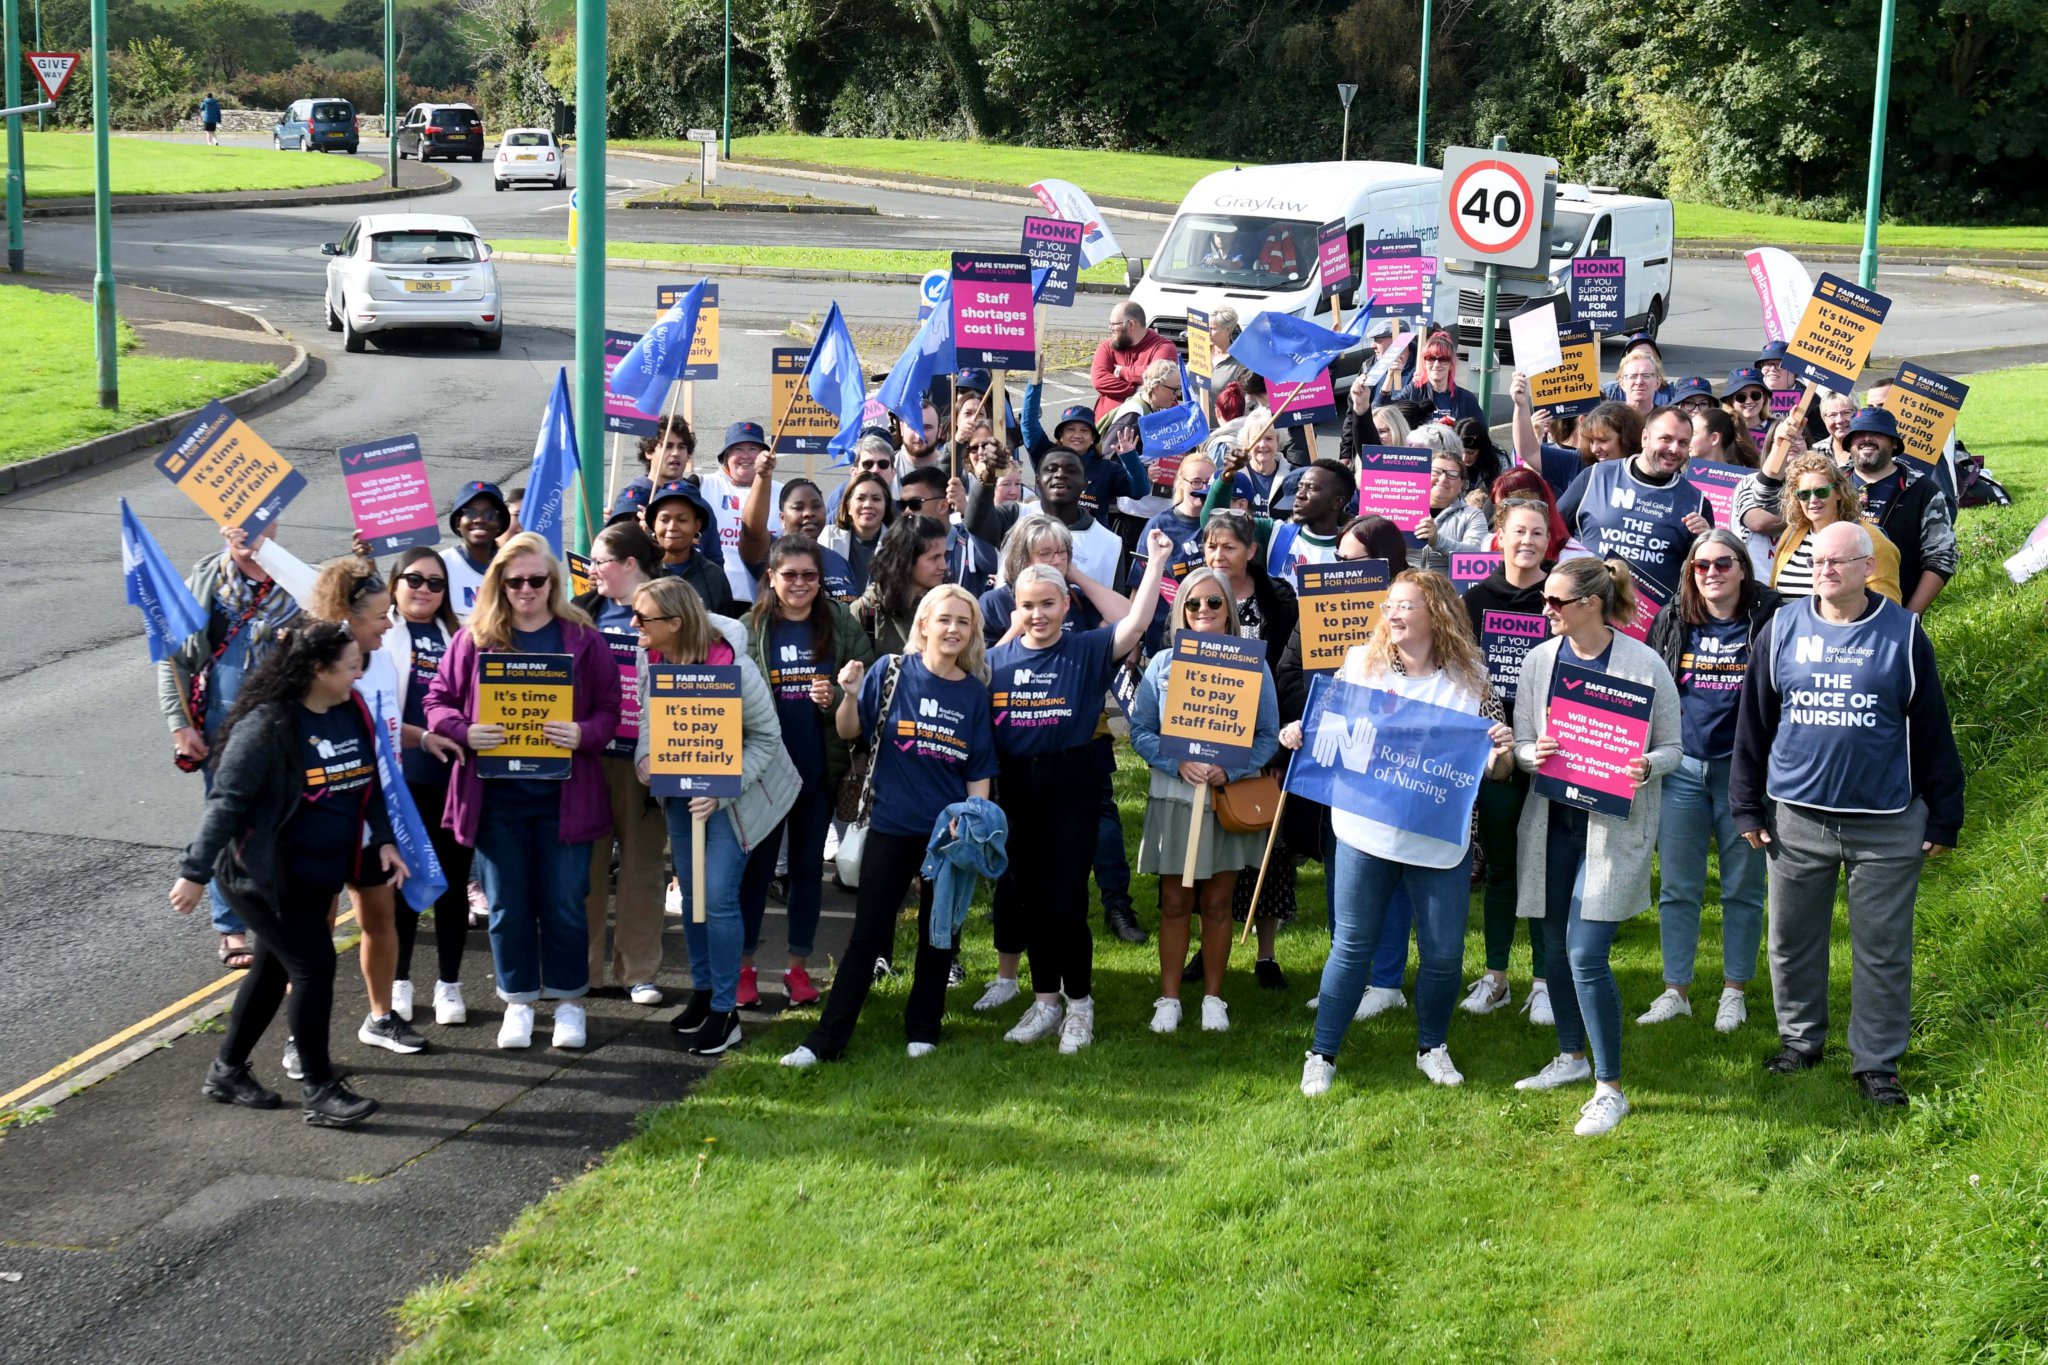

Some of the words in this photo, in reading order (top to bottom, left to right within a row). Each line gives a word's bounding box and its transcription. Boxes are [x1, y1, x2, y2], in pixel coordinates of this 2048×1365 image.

[38, 59, 68, 69] GIVE
[1214, 195, 1308, 212] Graylaw
[1461, 188, 1521, 228] 40
[1029, 222, 1077, 240] HONK
[1036, 241, 1045, 249] IF
[1046, 242, 1066, 252] YOU
[1028, 248, 1072, 262] SUPPORT
[993, 262, 1026, 270] STAFFING
[1577, 263, 1620, 274] HONK
[1584, 278, 1592, 286] IF
[1593, 278, 1612, 286] YOU
[1578, 286, 1618, 294] SUPPORT
[1838, 287, 1855, 300] FAIR
[1854, 293, 1871, 304] PAY
[976, 292, 1009, 304] Staff
[1578, 294, 1599, 302] FAIR
[1600, 294, 1617, 302] PAY
[1835, 293, 1850, 304] FOR
[1850, 299, 1882, 317] NURSING
[1588, 302, 1607, 310] FOR
[961, 307, 1027, 322] shortages
[1577, 310, 1618, 318] NURSING
[1818, 306, 1836, 321] It's
[1838, 314, 1866, 333] time
[964, 324, 992, 334] cost
[994, 323, 1025, 336] lives
[1819, 320, 1831, 332] to
[1832, 326, 1855, 343] pay
[1809, 331, 1854, 357] nursing
[1796, 339, 1825, 357] staff
[1826, 350, 1857, 371] fairly
[1559, 362, 1579, 375] pay
[1541, 372, 1585, 386] nursing
[1918, 376, 1935, 387] FAIR
[1935, 383, 1948, 392] PAY
[1536, 386, 1562, 398] staff
[1565, 382, 1593, 394] fairly
[1916, 382, 1930, 391] FOR
[1930, 388, 1960, 403] NURSING
[1899, 394, 1917, 408] It's
[1919, 403, 1945, 418] time
[1900, 408, 1912, 418] to
[1913, 415, 1935, 429] pay
[177, 436, 196, 455] FAIR
[192, 422, 209, 439] PAY
[1907, 436, 1936, 456] fairly
[193, 464, 214, 484] It's
[211, 438, 239, 465] time
[210, 475, 225, 488] to
[224, 452, 246, 477] pay
[219, 458, 262, 503] nursing
[223, 489, 250, 520] staff
[247, 461, 278, 492] fairly
[1636, 498, 1653, 508] Royal
[1653, 502, 1673, 513] College
[1641, 507, 1663, 519] Nursing
[1622, 516, 1653, 534] THE
[1600, 527, 1646, 547] VOICE
[1648, 538, 1670, 551] OF
[1323, 571, 1344, 580] FAIR
[1345, 570, 1363, 578] PAY
[1324, 579, 1342, 587] FOR
[1344, 576, 1384, 586] NURSING
[1315, 601, 1337, 613] It's
[1340, 599, 1375, 611] time
[1323, 617, 1339, 627] to
[1342, 616, 1369, 628] pay
[1489, 616, 1542, 633] HONK
[1200, 641, 1221, 652] FAIR
[1222, 644, 1241, 654] PAY
[1497, 635, 1506, 643] IF
[1508, 636, 1530, 647] YOU
[1200, 649, 1218, 658] FOR
[1219, 652, 1259, 664] NURSING
[1310, 645, 1344, 658] staff
[1826, 646, 1847, 655] Royal
[1847, 646, 1875, 657] College
[506, 662, 528, 670] FAIR
[1488, 654, 1513, 665] FAIR
[1825, 654, 1833, 663] of
[1835, 655, 1864, 667] Nursing
[527, 670, 568, 678] NURSING
[676, 674, 697, 682] FAIR
[698, 674, 716, 682] PAY
[1185, 669, 1207, 683] It's
[1211, 673, 1245, 688] time
[1811, 673, 1852, 689] THE
[676, 682, 694, 690] FOR
[696, 682, 736, 690] NURSING
[1585, 682, 1607, 693] SAFE
[1607, 687, 1648, 704] STAFFING
[494, 690, 517, 702] It's
[522, 691, 558, 702] time
[1010, 691, 1032, 699] FAIR
[1032, 691, 1048, 699] PAY
[1010, 699, 1029, 707] FOR
[1030, 697, 1066, 707] NURSING
[1190, 686, 1206, 698] to
[1208, 690, 1236, 704] pay
[1584, 689, 1609, 701] SAVES
[1610, 695, 1633, 707] LIVES
[1790, 691, 1846, 708] VOICE
[1850, 693, 1878, 709] OF
[501, 706, 517, 717] to
[521, 707, 550, 719] pay
[665, 704, 688, 716] It's
[691, 704, 725, 716] time
[1010, 711, 1033, 719] SAFE
[1033, 709, 1072, 719] STAFFING
[1182, 701, 1239, 720] nursing
[1010, 719, 1037, 727] SAVES
[1038, 717, 1059, 726] LIVES
[1170, 714, 1206, 728] staff
[1208, 718, 1246, 737] fairly
[1568, 712, 1587, 724] Will
[1588, 718, 1613, 731] there
[1615, 726, 1628, 735] be
[1790, 708, 1877, 728] NURSING
[673, 720, 688, 732] to
[692, 721, 719, 734] pay
[1551, 718, 1588, 735] enough
[1590, 727, 1612, 741] staff
[1613, 735, 1640, 748] when
[667, 736, 724, 750] nursing
[1558, 730, 1576, 741] you
[1578, 735, 1602, 747] need
[1603, 743, 1629, 755] care?
[658, 751, 692, 763] staff
[695, 750, 734, 765] fairly
[1380, 745, 1420, 771] Royal
[1422, 758, 1475, 788] College
[1566, 761, 1586, 773] cost
[1588, 766, 1610, 779] lives
[1374, 766, 1392, 782] of
[1392, 770, 1448, 804] Nursing
